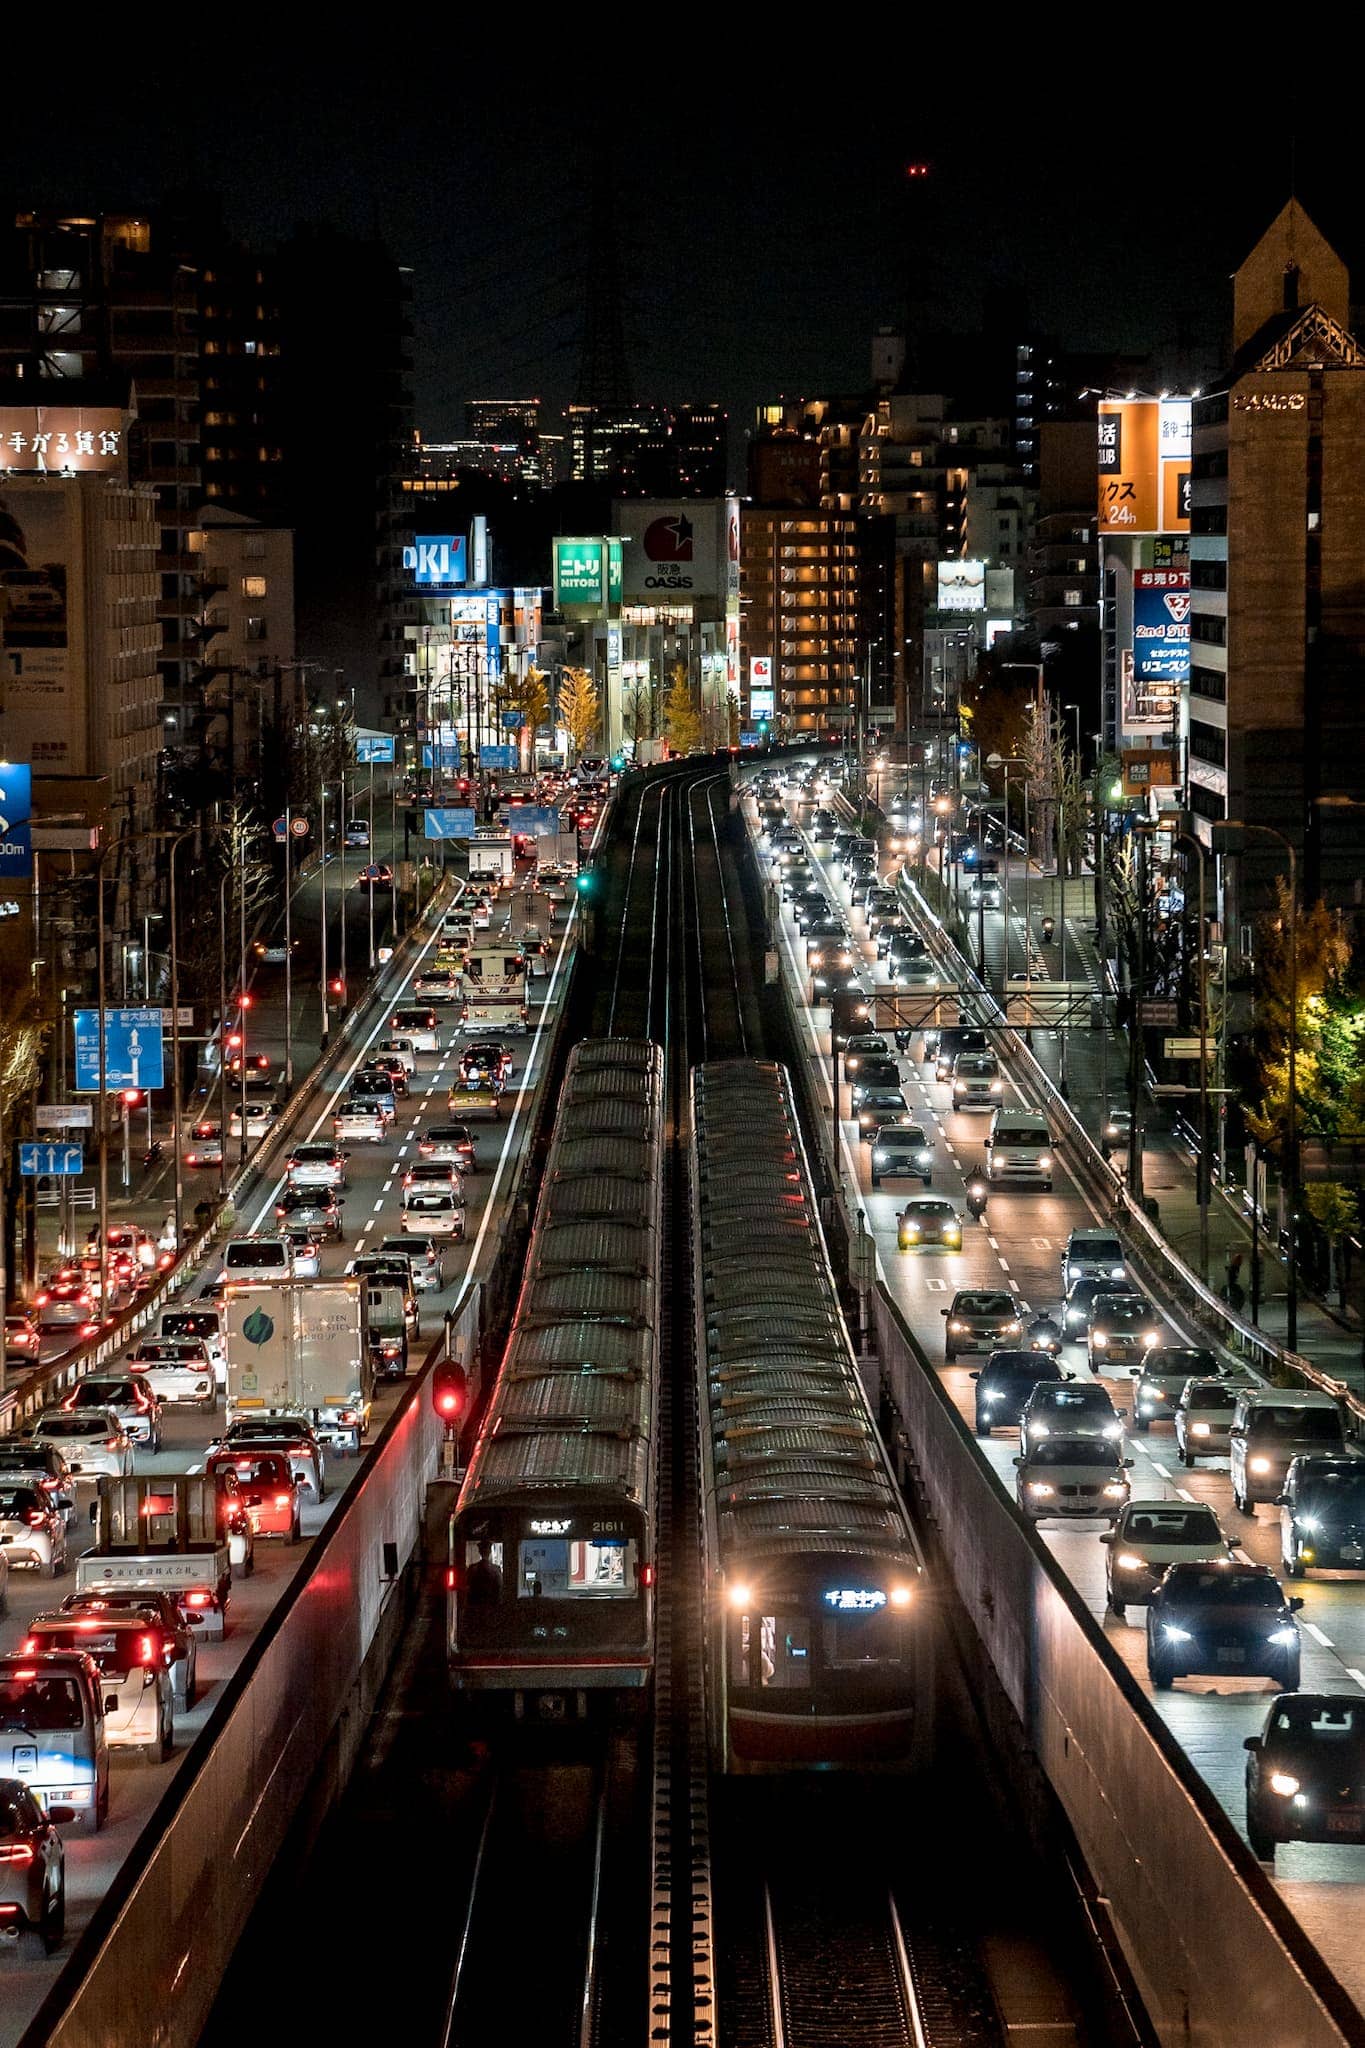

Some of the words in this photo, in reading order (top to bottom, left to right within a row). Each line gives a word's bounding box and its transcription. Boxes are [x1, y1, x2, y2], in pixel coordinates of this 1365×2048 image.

[0, 430, 120, 455] 手がる賃貸
[561, 560, 599, 575] ニトリ
[561, 578, 599, 588] NITORI
[645, 576, 693, 589] OASIS
[1135, 624, 1165, 638] 2nd
